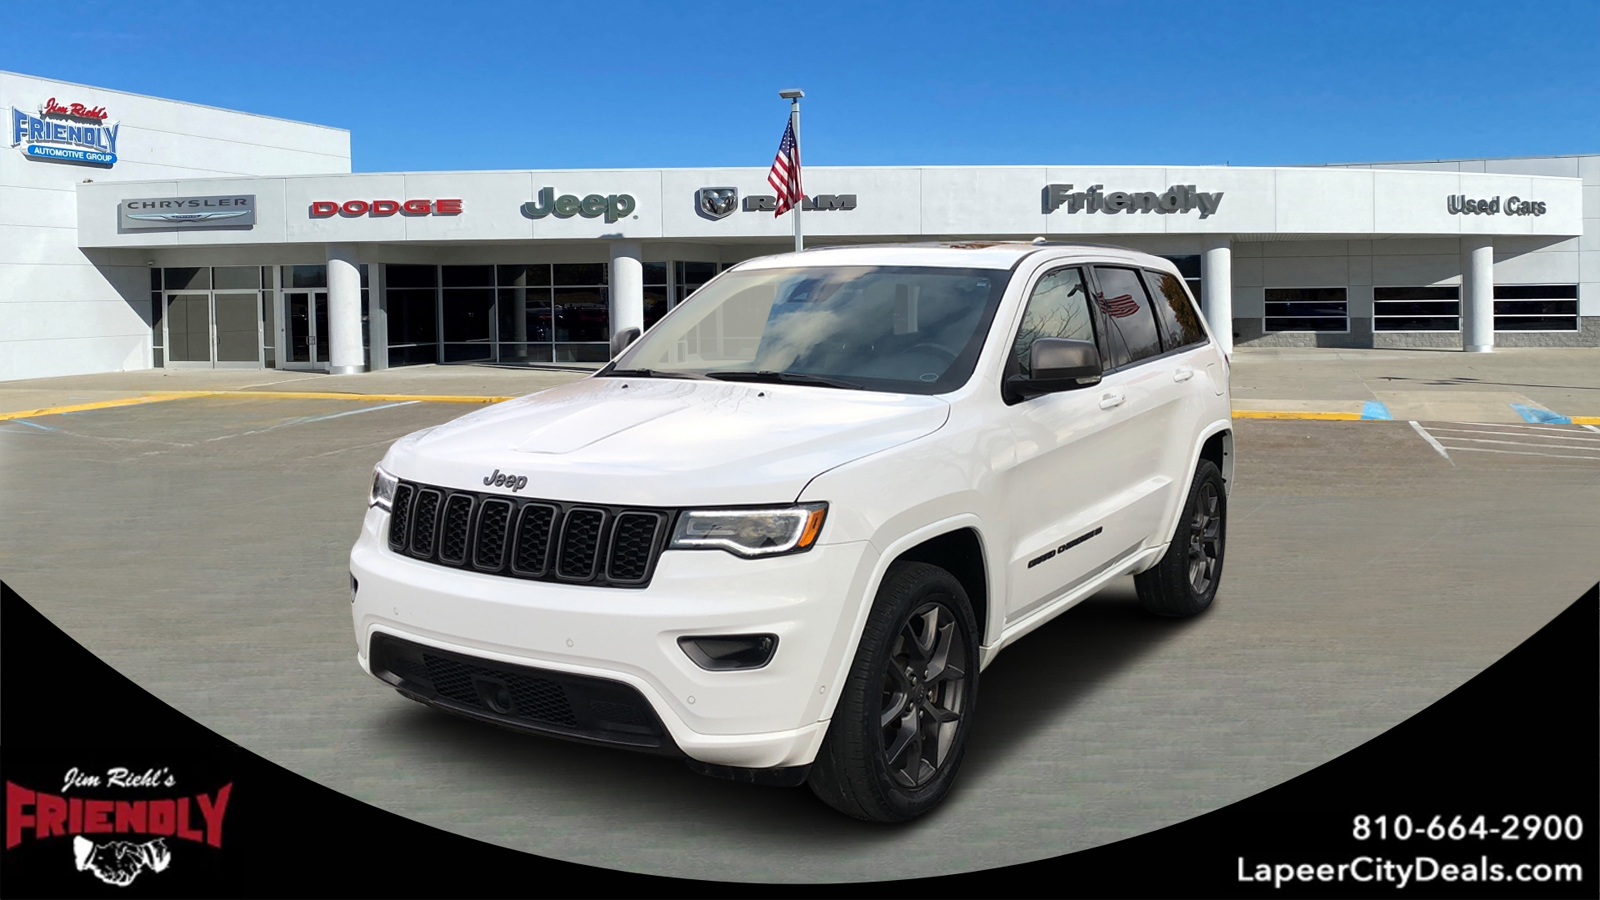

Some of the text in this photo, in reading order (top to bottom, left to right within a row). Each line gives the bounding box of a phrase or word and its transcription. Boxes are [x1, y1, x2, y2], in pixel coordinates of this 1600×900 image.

[44, 97, 68, 114] Jim
[12, 106, 121, 154] FRIENDLY
[34, 146, 113, 162] AUTOMOTIVE GROUP
[127, 198, 248, 210] CHRYSLER
[310, 198, 464, 219] DODGE
[522, 186, 637, 223] Jeep
[1041, 184, 1225, 219] Friendly
[1447, 194, 1547, 217] Used Cars
[483, 468, 528, 493] Jeep
